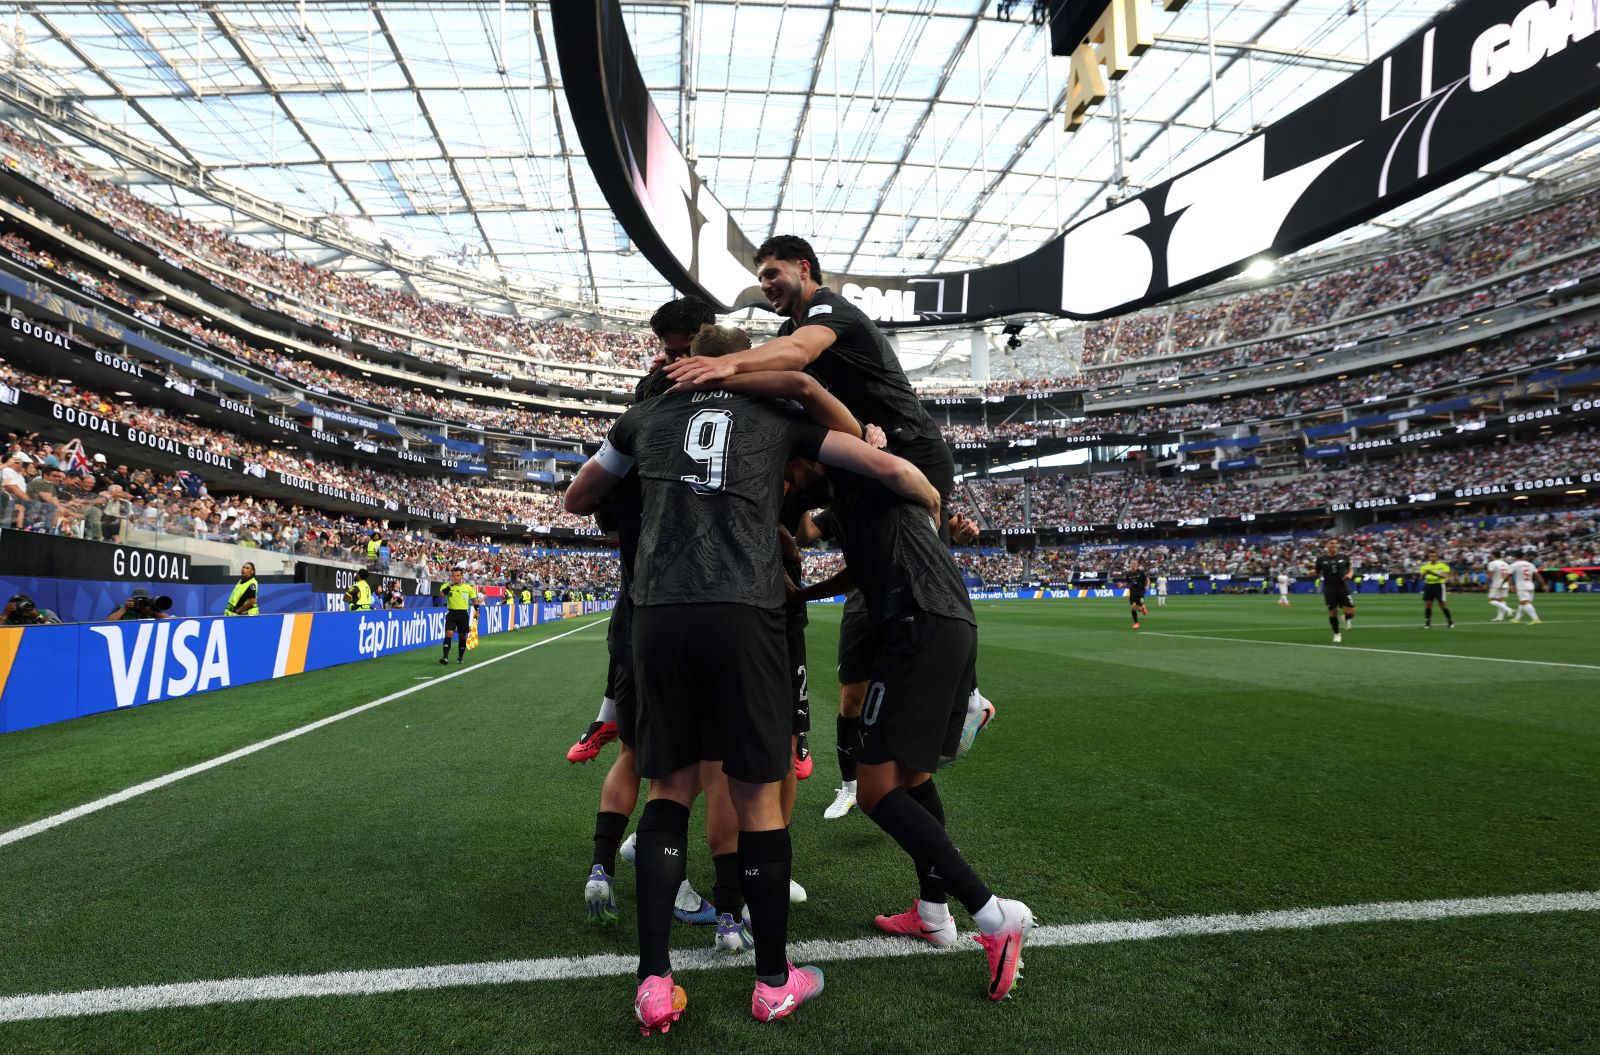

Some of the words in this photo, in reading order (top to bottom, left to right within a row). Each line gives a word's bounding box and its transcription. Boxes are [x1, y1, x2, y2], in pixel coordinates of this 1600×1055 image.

[1470, 0, 1600, 92] GOA
[842, 283, 920, 322] GOAL
[11, 317, 71, 350] GOOOAL
[95, 350, 143, 378] GOOOAL
[219, 398, 255, 418] GOOOAL
[268, 415, 299, 432] GOOOAL
[311, 429, 338, 445] GOOOAL
[398, 451, 426, 464] GOOOAL
[442, 459, 458, 468] GOO
[312, 406, 325, 417] FIFA
[325, 410, 347, 422] WORLD
[347, 415, 359, 424] CUP
[359, 418, 379, 430] 2026
[1349, 439, 1394, 451] GOOOAL
[1400, 430, 1443, 443] GOOOAL
[1507, 408, 1561, 424] GOOOAL
[681, 408, 733, 495] 9
[1067, 435, 1102, 443] GOOOAL
[53, 403, 119, 437] GOOOAL
[128, 427, 181, 455] GOOOAL
[187, 446, 233, 470] GOOOAL
[280, 473, 315, 492] GOOOAL
[318, 483, 348, 500] GOOOAL
[350, 493, 378, 507] GOOOAL
[407, 505, 431, 518] GOOOAL
[1058, 525, 1095, 533] GOOOAL
[1116, 522, 1155, 530] GOOOAL
[1355, 497, 1398, 509] GOOOAL
[1455, 485, 1508, 498] GOOOAL
[1514, 477, 1573, 491] GOOOAL
[113, 549, 190, 580] GOOOAL
[988, 591, 1003, 599] with
[1004, 591, 1018, 599] VISA
[1050, 590, 1070, 598] VISA
[1094, 589, 1114, 597] VISA
[485, 606, 503, 634] VISA
[518, 604, 530, 628] VISA
[358, 615, 385, 658] tap
[386, 611, 400, 649] in
[402, 610, 427, 647] with
[90, 619, 231, 708] VISA
[797, 664, 808, 702] 2
[664, 847, 679, 857] NZ
[745, 868, 759, 876] NZ
